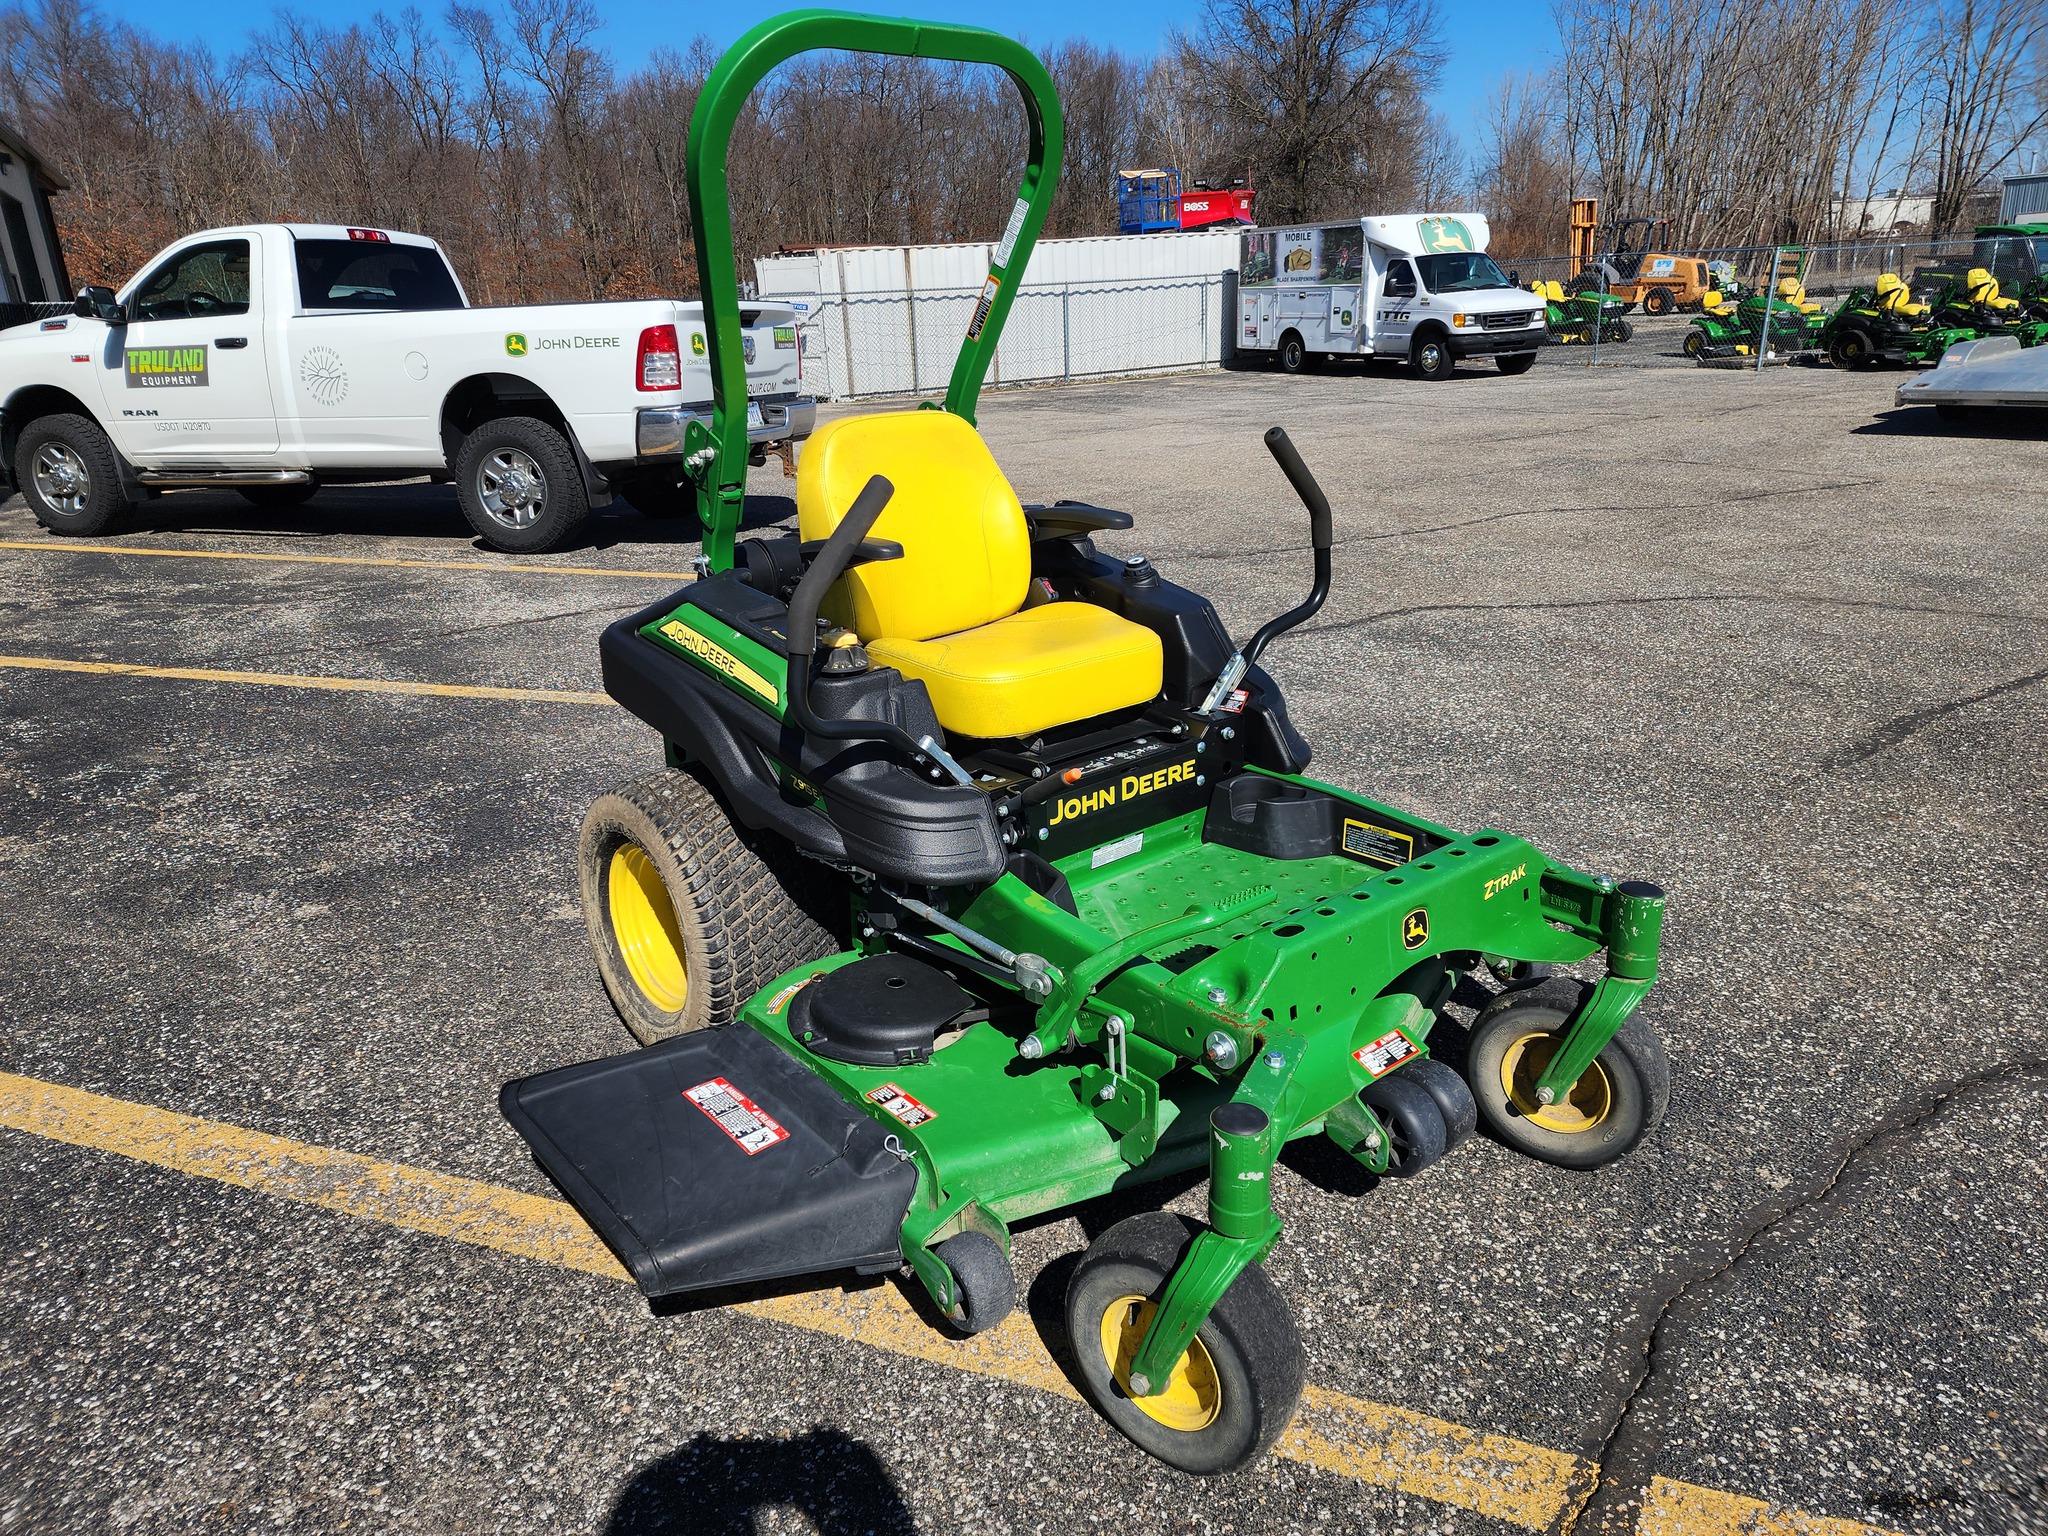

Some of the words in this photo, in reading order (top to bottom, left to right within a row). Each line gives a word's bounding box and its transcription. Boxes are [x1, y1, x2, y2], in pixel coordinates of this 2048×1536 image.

[1183, 201, 1209, 212] BOSS
[1285, 232, 1312, 242] MOBILE
[1383, 311, 1411, 322] TTG
[534, 337, 571, 350] JOHN
[574, 336, 620, 348] DEERE
[308, 346, 340, 360] PROVIDER
[127, 348, 204, 375] TRULAND
[141, 375, 197, 387] EQUIPMENT
[747, 382, 777, 394] QUIP.COM
[312, 393, 335, 407] MEANS
[335, 371, 348, 405] PARTNER
[122, 409, 159, 417] RAM
[154, 422, 180, 431] USDOT
[182, 422, 211, 431] 4120870
[670, 623, 699, 653] JOHN
[699, 639, 736, 675] DEERE
[1049, 785, 1116, 826] JOHN
[1121, 758, 1196, 801] DEERE
[1483, 861, 1527, 901] ZTRAK
[758, 1112, 779, 1131] PELIGRO
